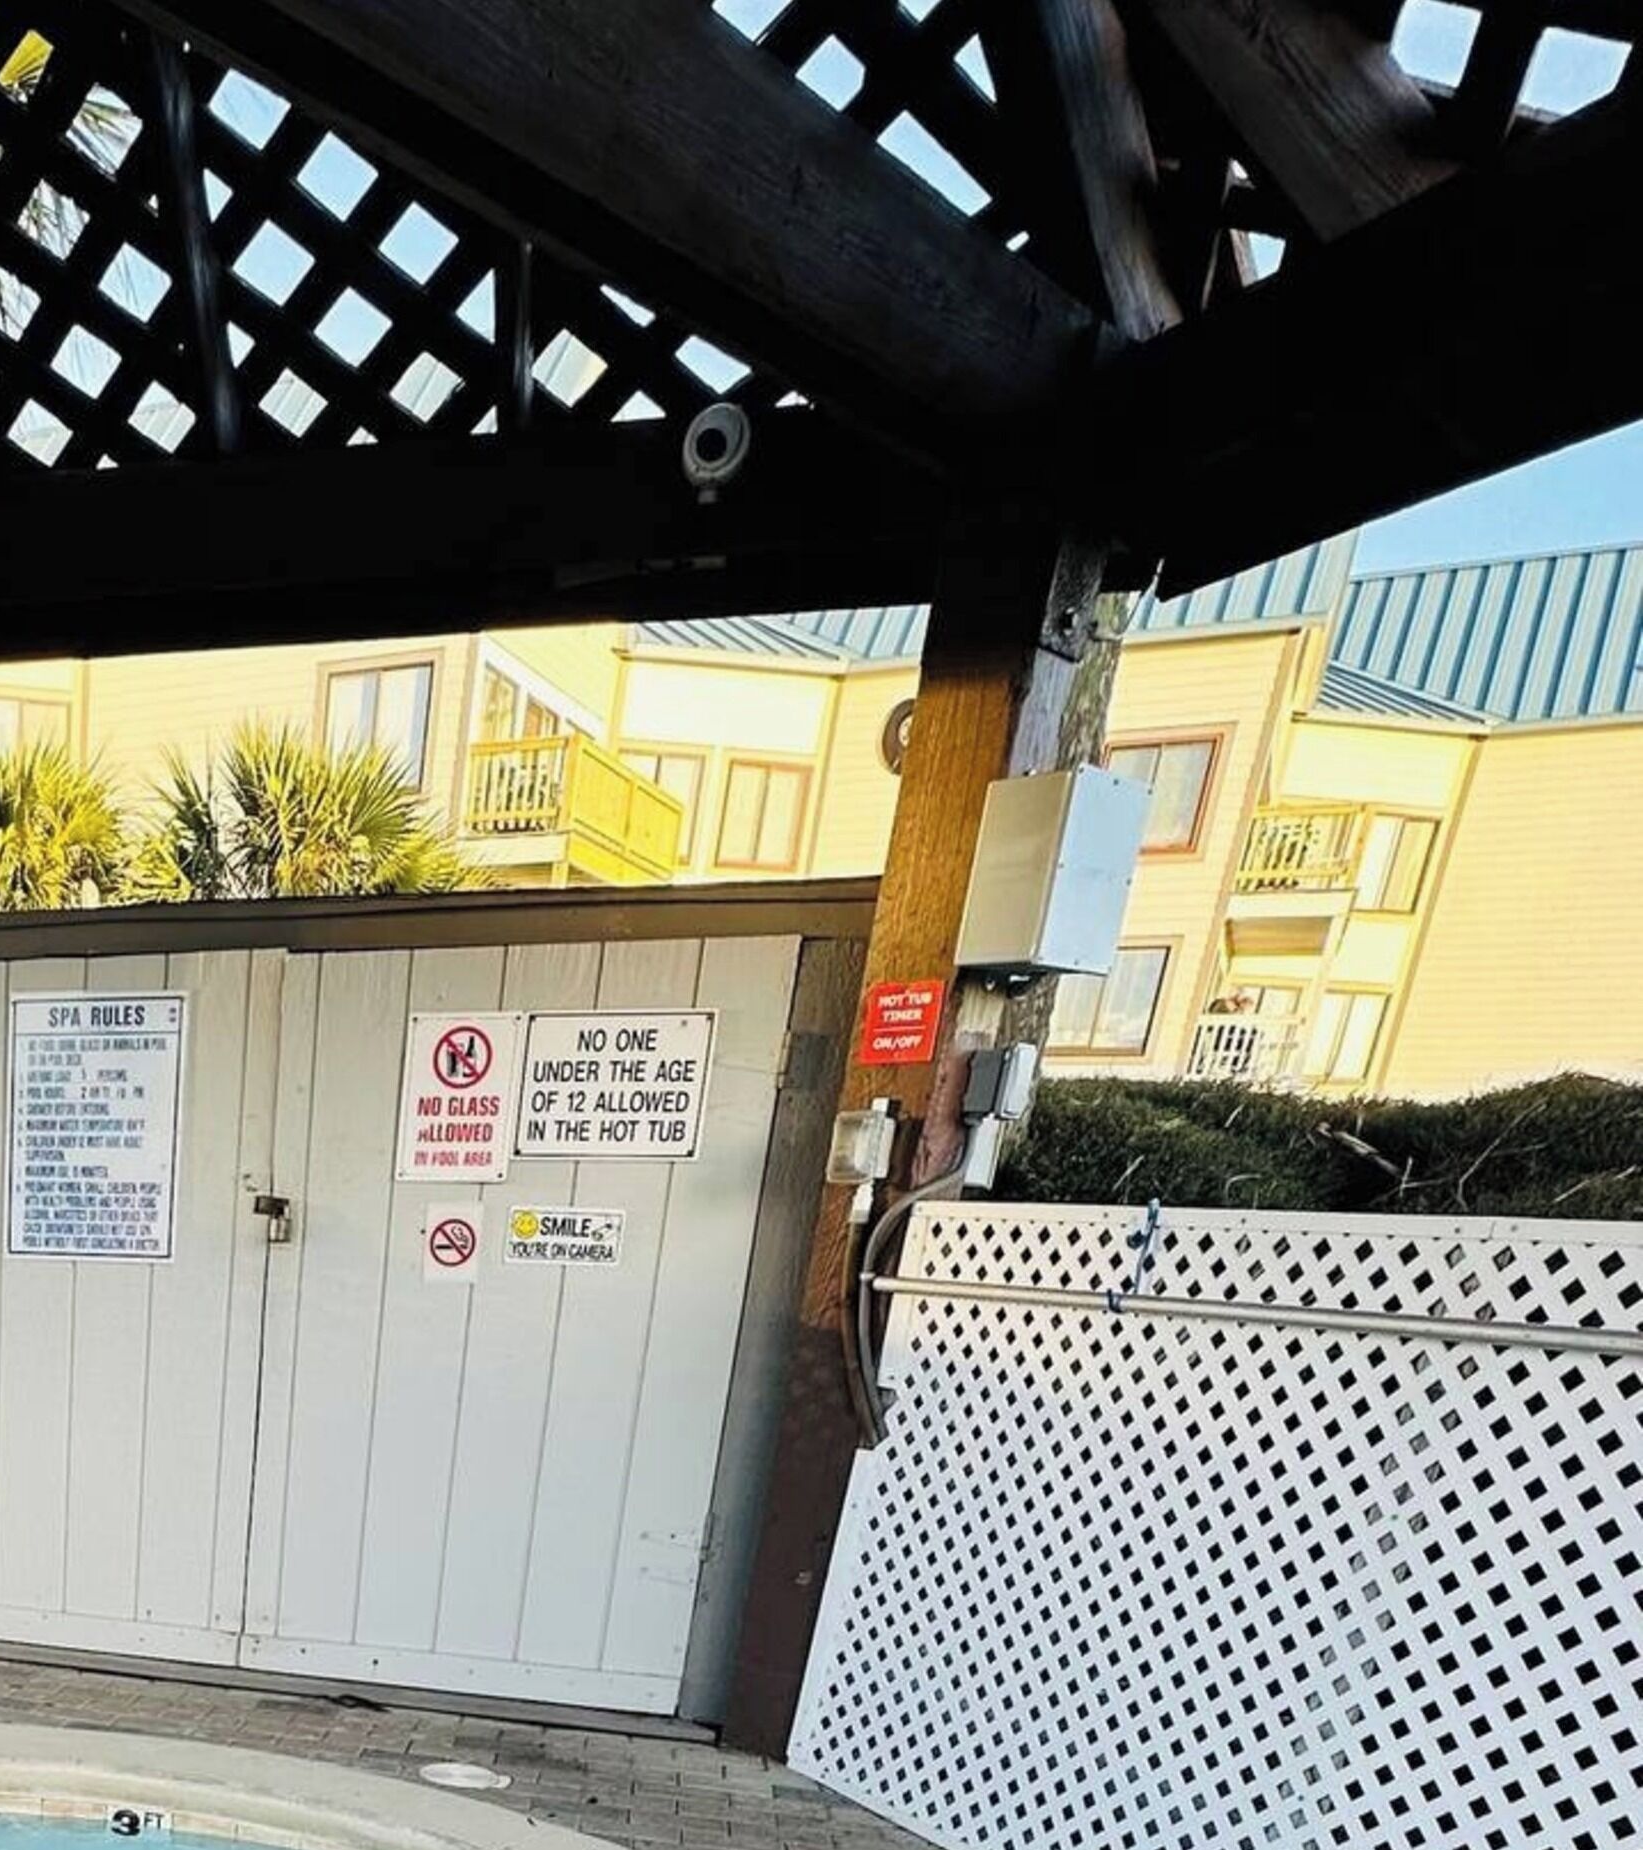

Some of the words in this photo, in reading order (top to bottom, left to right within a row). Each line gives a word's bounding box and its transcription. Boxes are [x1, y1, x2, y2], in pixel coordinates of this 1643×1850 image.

[878, 994, 904, 1007] HOT
[907, 992, 933, 1004] TUB
[48, 1007, 81, 1028] SPA
[90, 1006, 145, 1028] RULES
[882, 1009, 924, 1022] TIMER
[577, 1028, 607, 1051] NO
[615, 1028, 659, 1051] ONE
[872, 1035, 924, 1050] ON/OFF
[533, 1060, 599, 1083] UNDER
[608, 1060, 647, 1082] THE
[654, 1060, 697, 1082] AGE
[417, 1097, 442, 1116] NO
[448, 1096, 500, 1116] GLASS
[531, 1090, 558, 1113] OF
[566, 1090, 586, 1112] 12
[593, 1090, 690, 1113] ALLOWED
[527, 1120, 548, 1141] IN
[553, 1120, 591, 1142] THE
[598, 1120, 639, 1142] HOT
[646, 1120, 686, 1142] TUB
[414, 1151, 429, 1166] IN
[463, 1151, 493, 1166] AREA
[540, 1216, 592, 1238] SMILE
[551, 1242, 566, 1259] ON
[568, 1243, 613, 1260] CAMERA
[144, 1812, 165, 1830] FT
